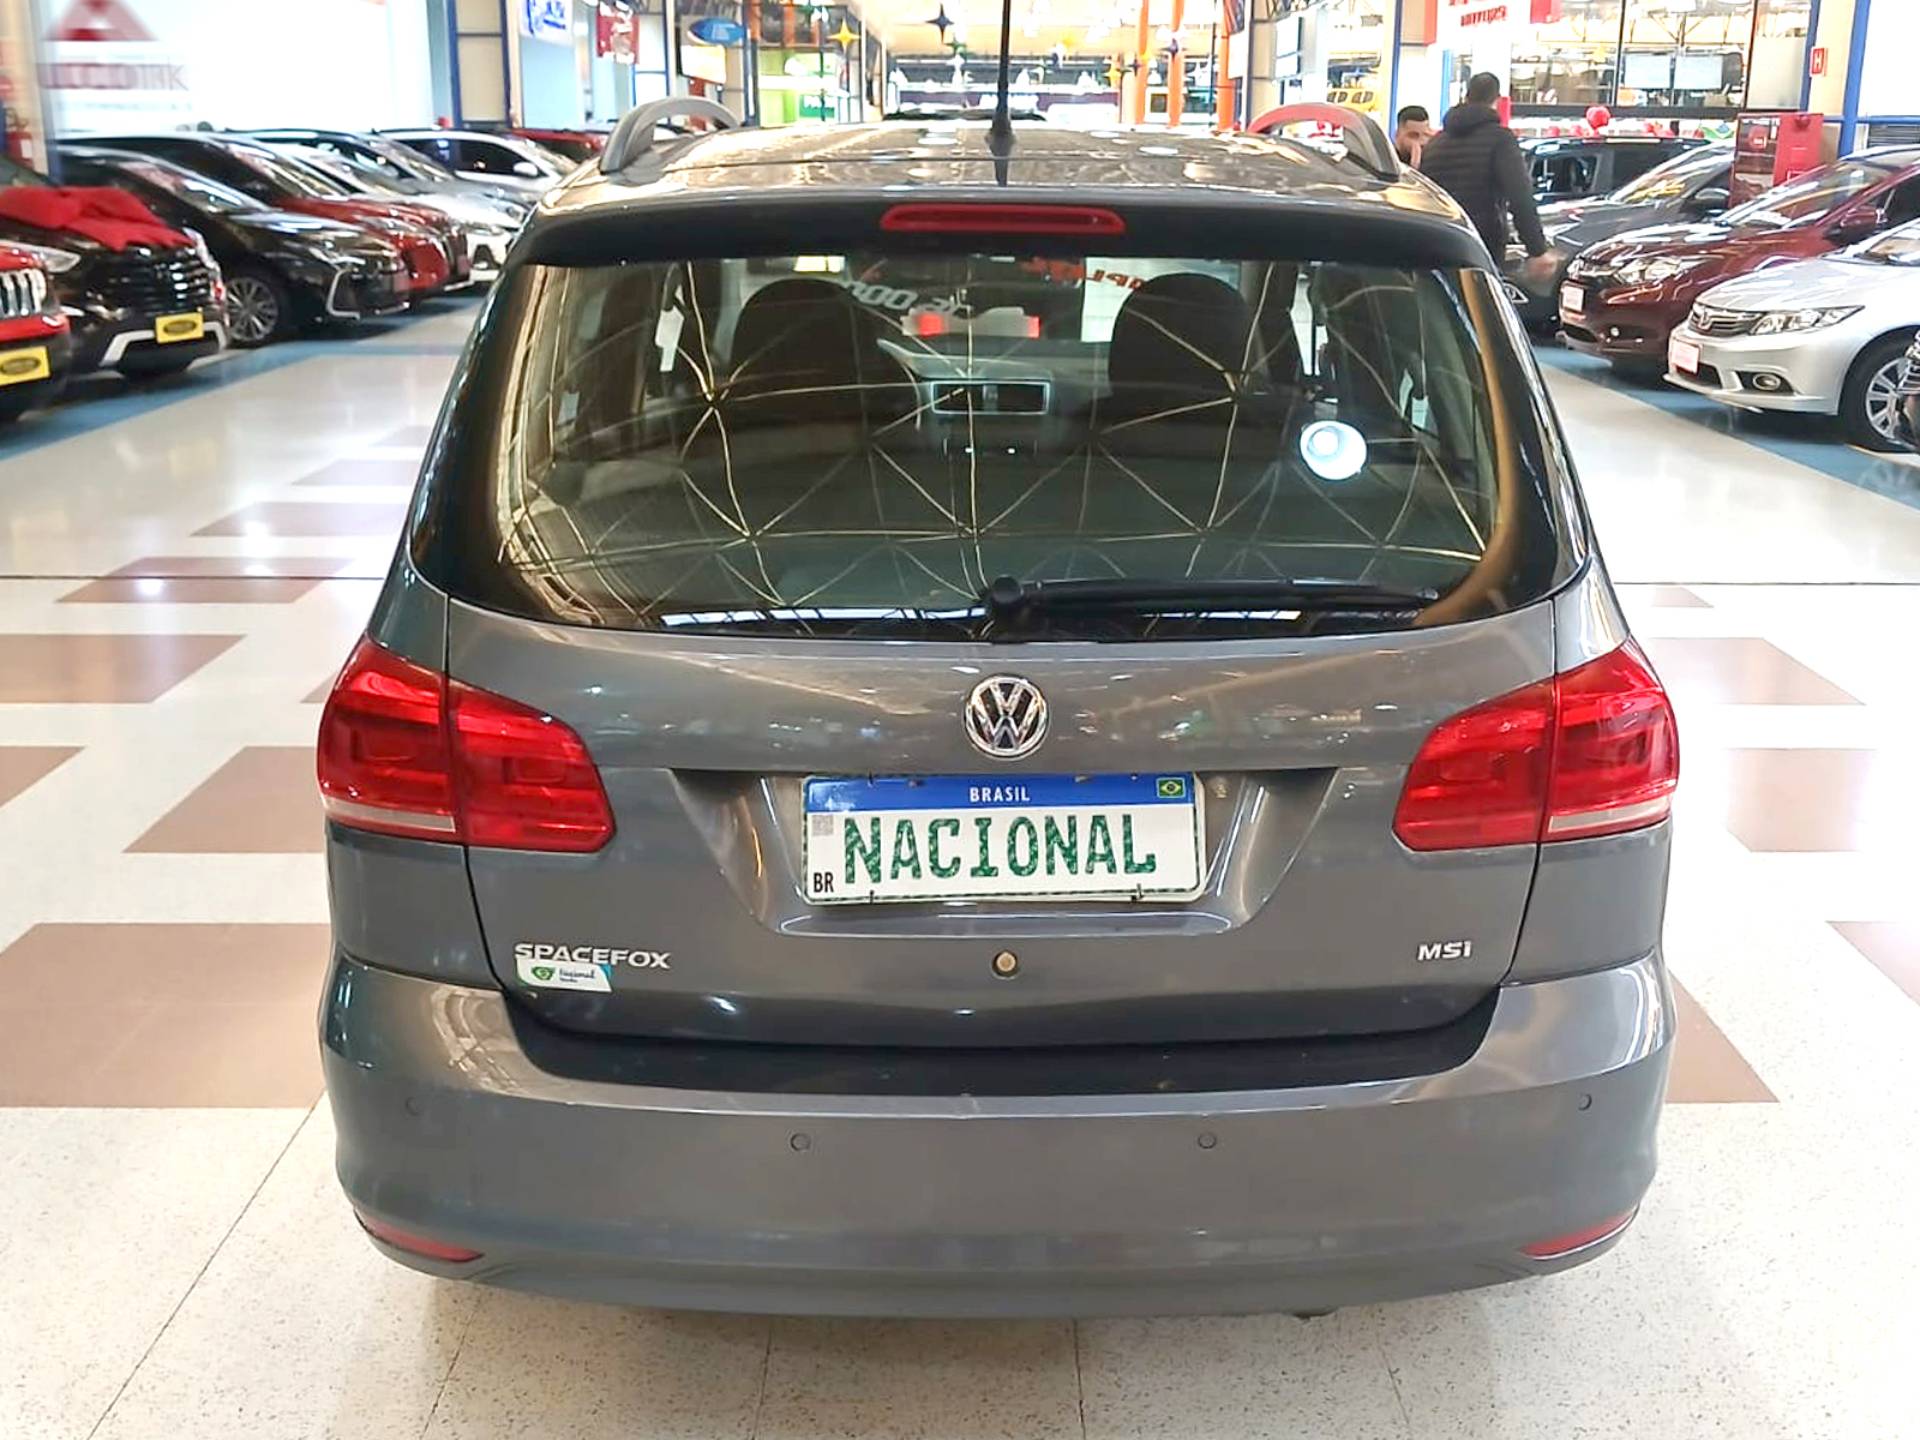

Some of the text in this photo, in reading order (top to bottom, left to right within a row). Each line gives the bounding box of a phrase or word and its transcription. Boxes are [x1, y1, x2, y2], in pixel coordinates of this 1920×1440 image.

[969, 787, 1031, 802] BRASIL
[843, 814, 1157, 884] NACIONAL
[813, 872, 834, 893] BR
[515, 943, 672, 968] SPACEFOX
[1417, 940, 1472, 961] MSI
